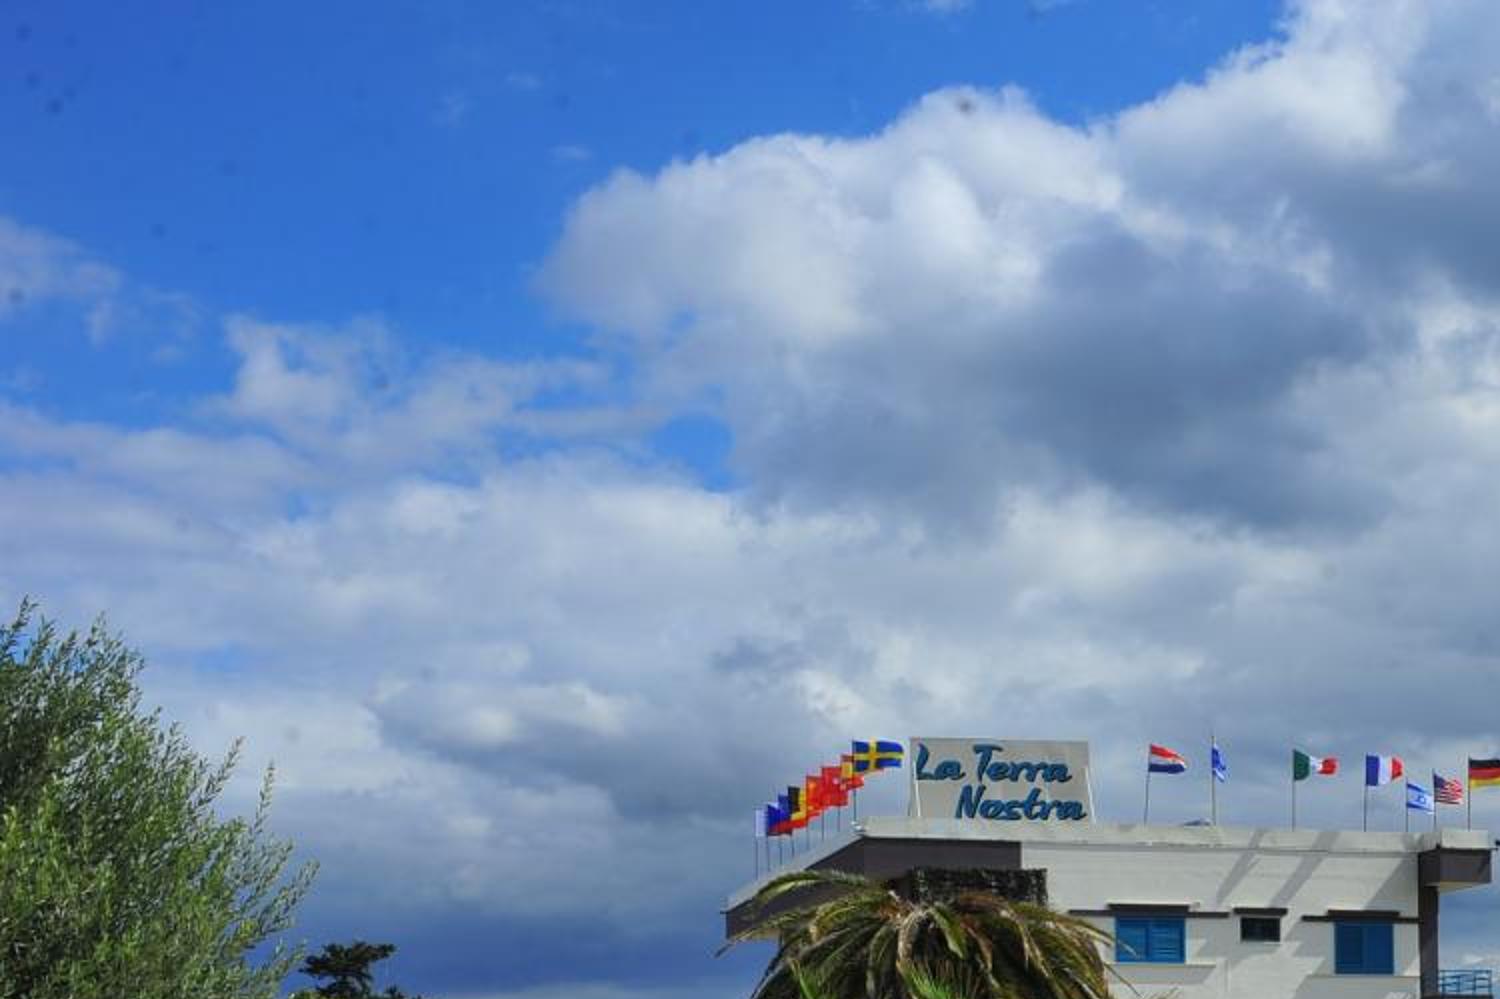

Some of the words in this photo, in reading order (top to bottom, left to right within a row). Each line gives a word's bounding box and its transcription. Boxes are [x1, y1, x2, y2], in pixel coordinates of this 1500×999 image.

[916, 743, 966, 781] La
[973, 744, 1072, 782] Terra
[955, 784, 1087, 820] Nostra
